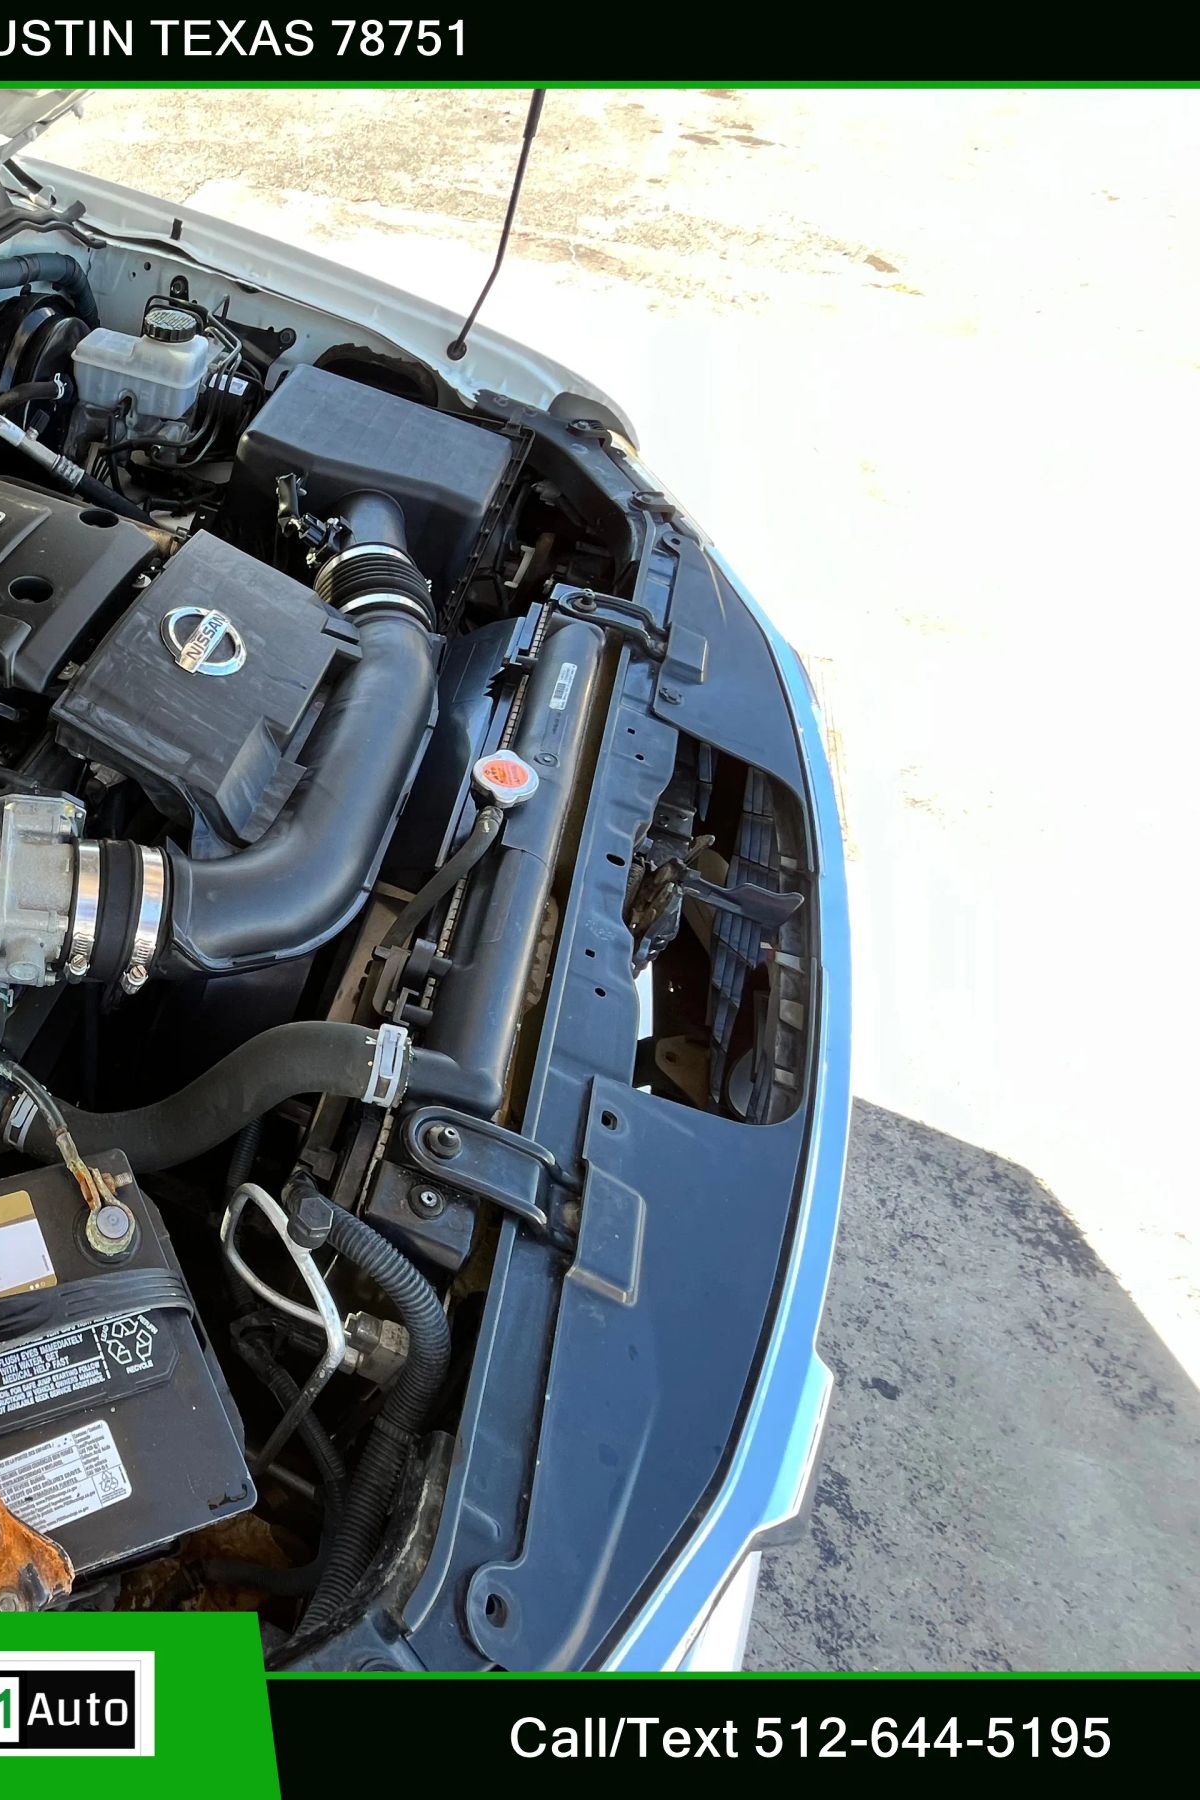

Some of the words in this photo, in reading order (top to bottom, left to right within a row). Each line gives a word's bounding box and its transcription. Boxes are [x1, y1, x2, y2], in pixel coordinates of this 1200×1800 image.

[186, 613, 227, 661] NISSAN
[101, 1324, 109, 1342] LEAD
[137, 1314, 159, 1335] RETURN
[20, 1347, 39, 1360] EYES
[38, 1333, 83, 1354] IMMEDIATELY
[0, 1363, 17, 1376] WITH
[44, 1350, 59, 1362] GET
[1, 1368, 32, 1384] MEDICAL
[32, 1361, 51, 1374] HELP
[51, 1355, 69, 1368] FAST
[126, 1360, 154, 1374] RECYCLE
